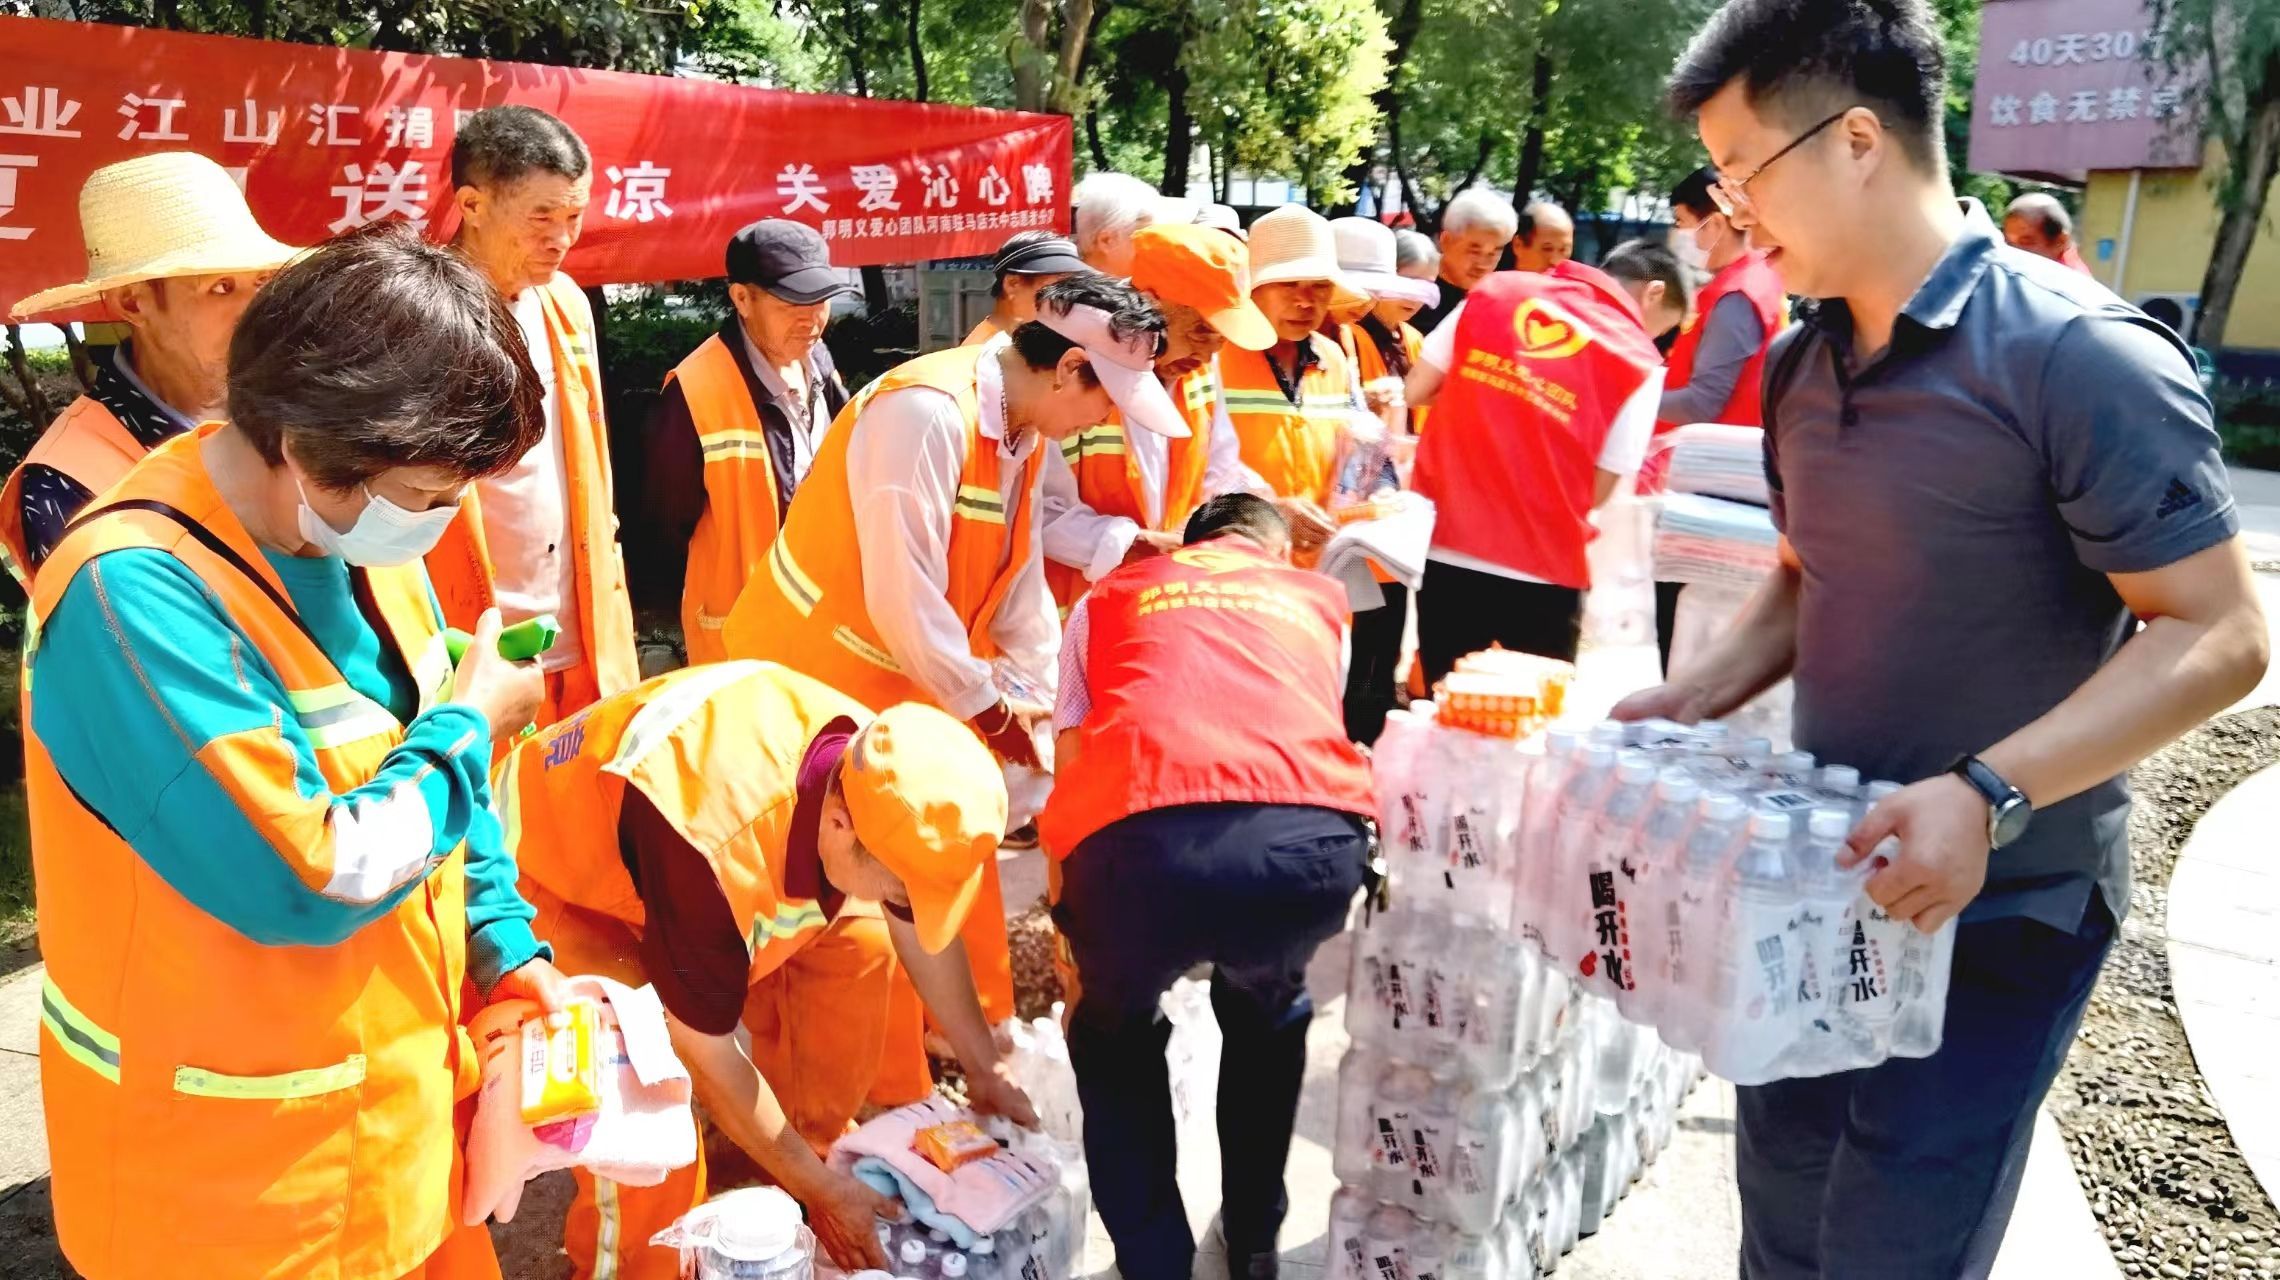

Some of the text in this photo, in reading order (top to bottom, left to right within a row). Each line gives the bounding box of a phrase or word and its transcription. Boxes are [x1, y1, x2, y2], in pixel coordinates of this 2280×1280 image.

[0, 86, 475, 149] 业江山汇捐
[776, 162, 1055, 215] 关爱沁心脾
